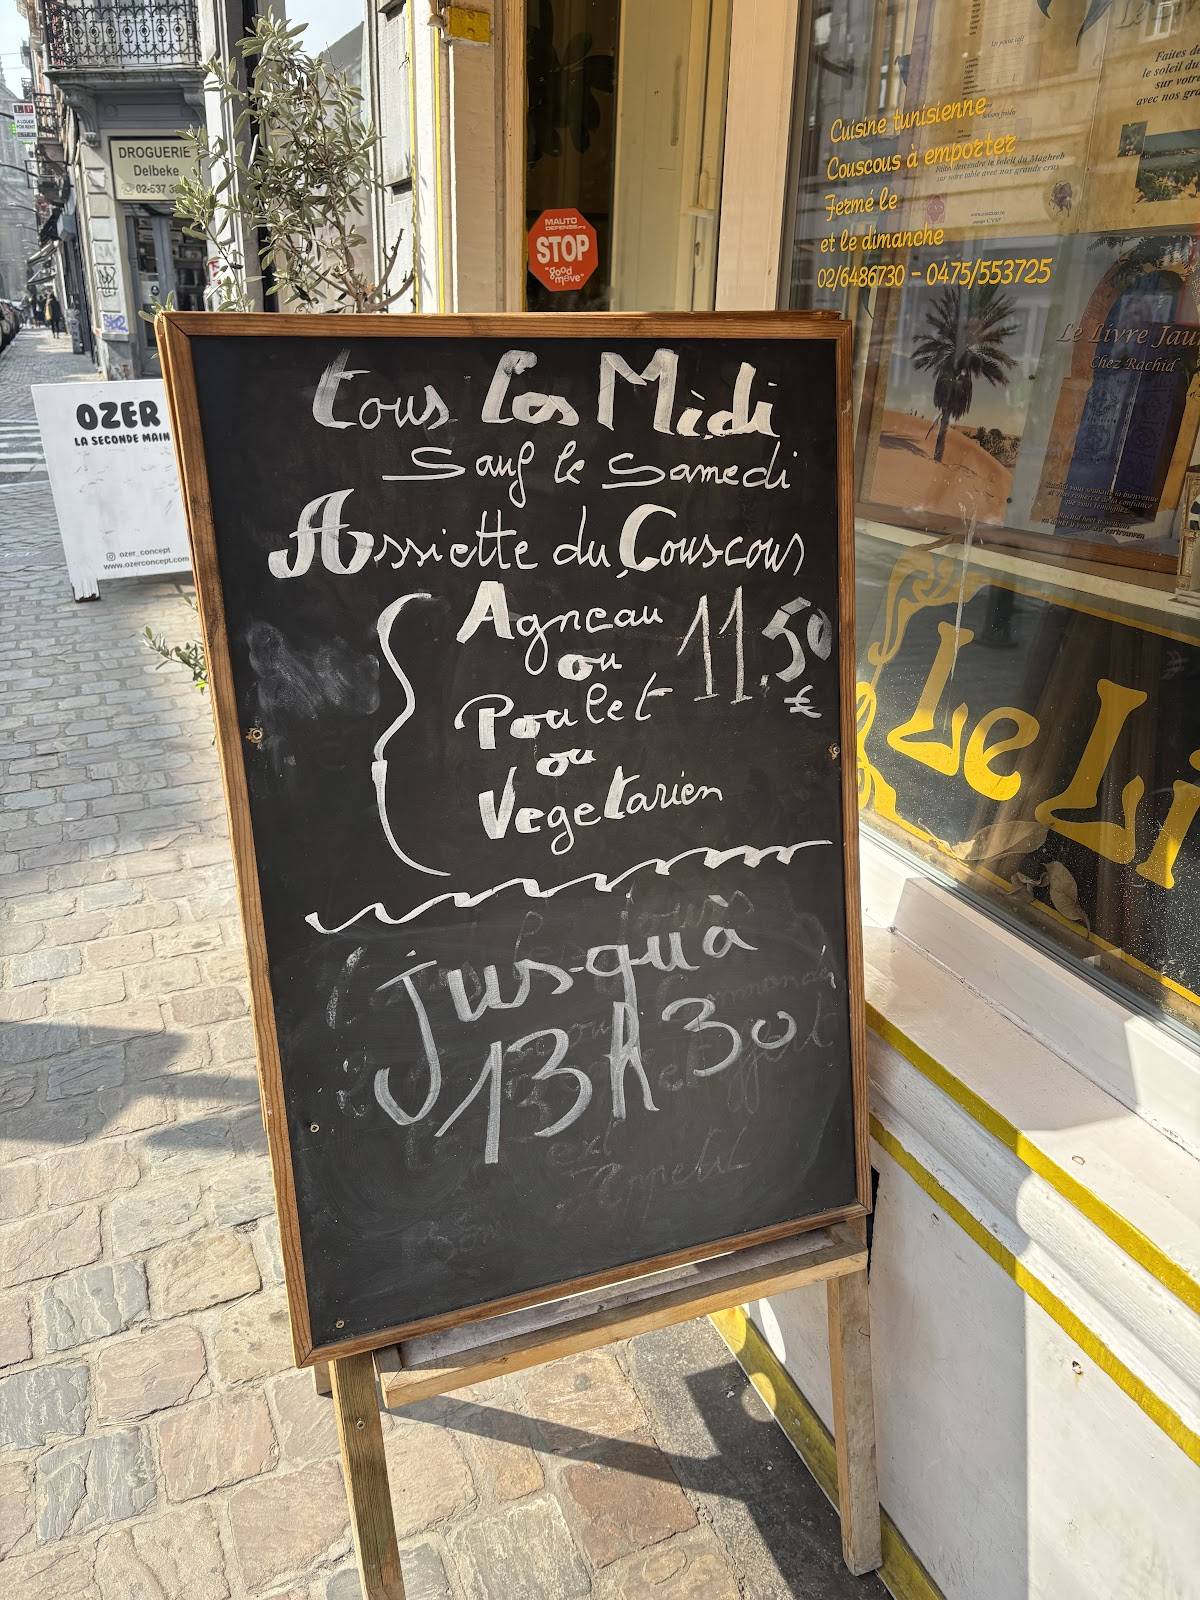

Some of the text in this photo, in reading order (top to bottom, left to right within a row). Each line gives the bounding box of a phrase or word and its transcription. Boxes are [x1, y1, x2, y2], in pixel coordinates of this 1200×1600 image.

[1142, 68, 1152, 78] le
[1154, 62, 1183, 77] soleil
[1155, 49, 1186, 62] Faites
[1136, 96, 1158, 106] avec
[1161, 91, 1181, 102] nos
[1155, 79, 1173, 90] sur
[830, 117, 887, 144] Cuisine
[893, 96, 988, 131] tunisienne
[118, 146, 192, 159] DROGUERIE
[827, 131, 1017, 181] Couscous à emporter
[133, 164, 180, 177] Delbeke
[824, 186, 898, 222] Fermé le
[536, 234, 590, 264] STOP
[820, 222, 945, 253] et le dimanche
[817, 264, 905, 292] 02/6486730
[926, 258, 1053, 289] 0475/553725
[1056, 321, 1200, 349] Le Livre Jau
[1090, 354, 1181, 374] Chez Rachid
[76, 400, 161, 430] OZER
[74, 431, 171, 447] LA SECONDE MAIN
[554, 440, 585, 484] le
[119, 546, 171, 559] ozer_concept
[552, 504, 612, 567] du
[616, 503, 805, 578] Couscous
[103, 556, 190, 571] www.ozerconcept.com
[456, 580, 664, 676] Agneau
[557, 652, 622, 682] ou
[454, 672, 673, 750] Poulet
[887, 621, 1041, 801] Le
[536, 748, 597, 777] ou
[478, 765, 723, 855] Vegetarien
